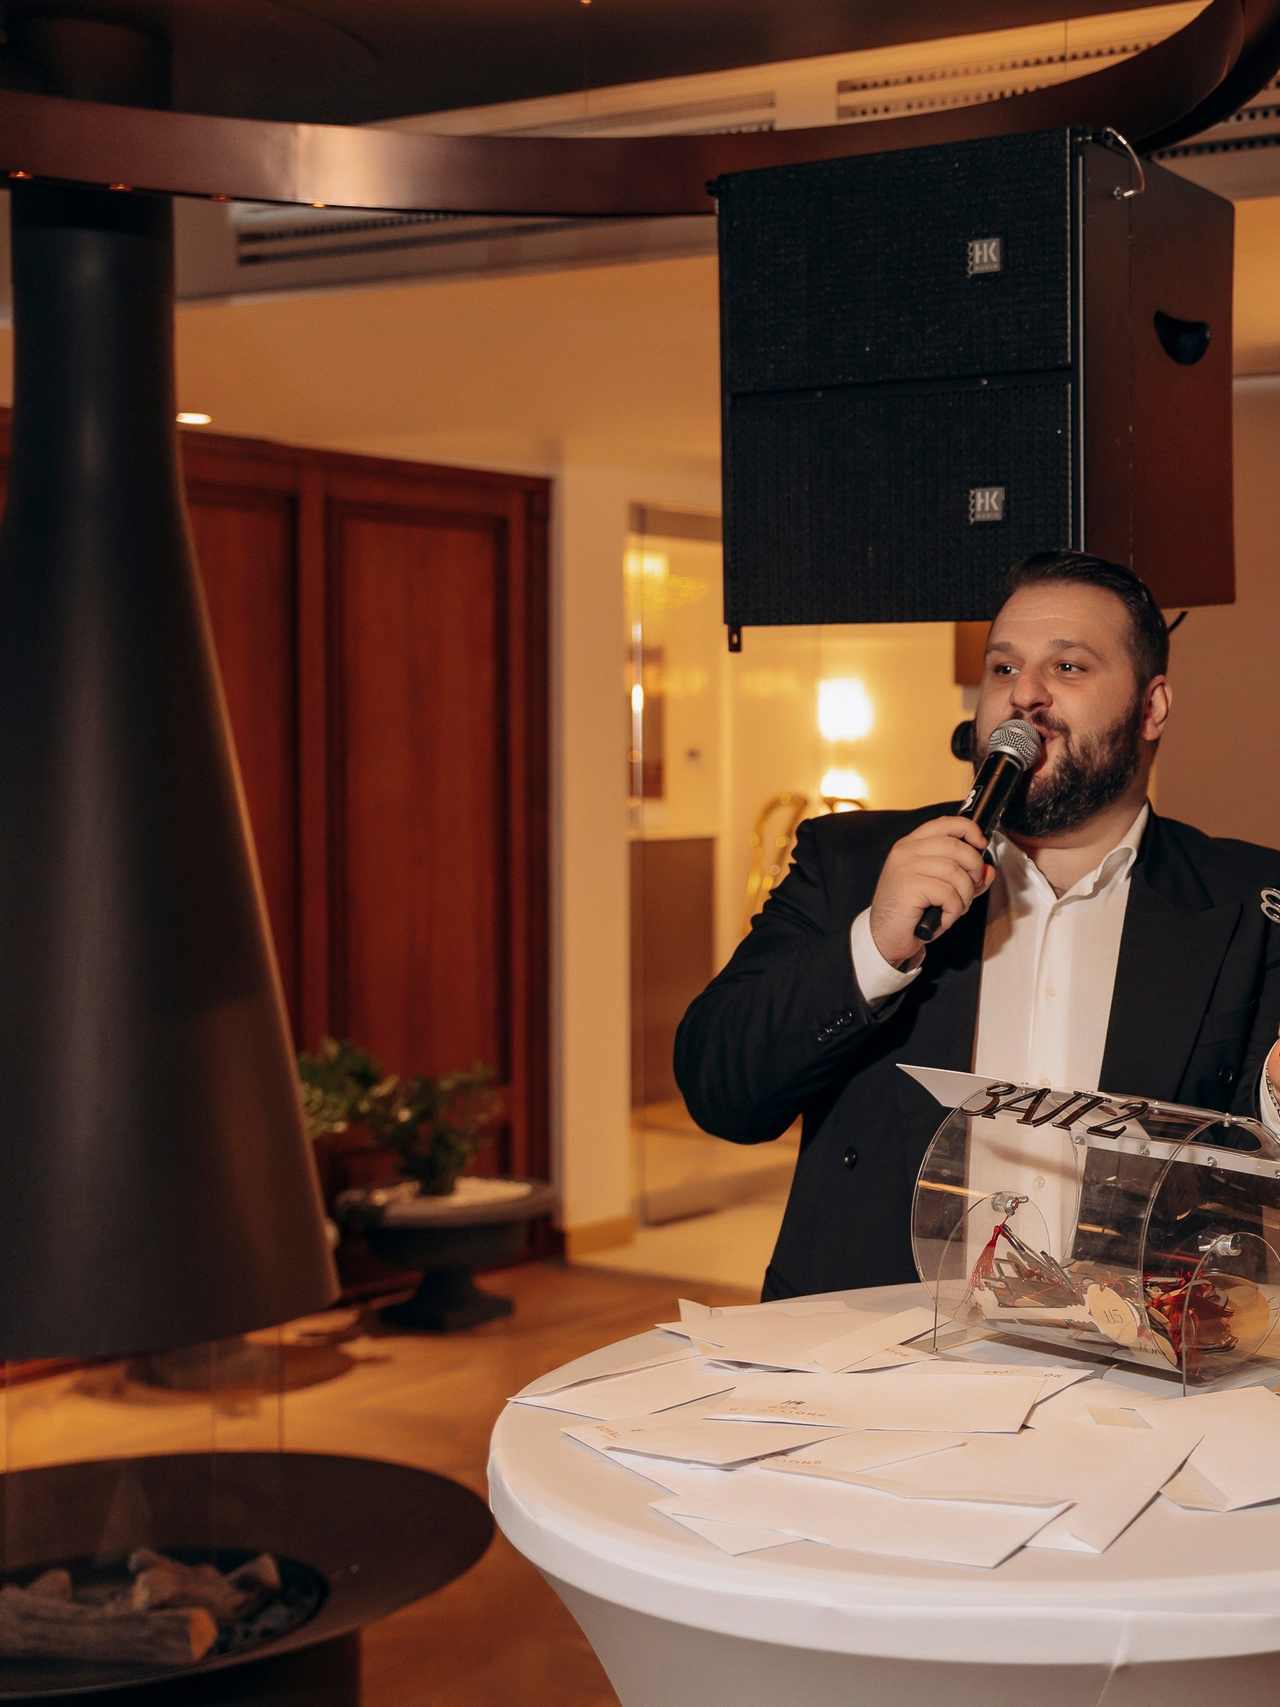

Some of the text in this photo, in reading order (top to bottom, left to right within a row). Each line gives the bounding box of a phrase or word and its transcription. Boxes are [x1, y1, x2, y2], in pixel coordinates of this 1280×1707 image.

[975, 242, 998, 264] HK
[977, 491, 999, 512] HK
[1103, 1309, 1124, 1324] 115
